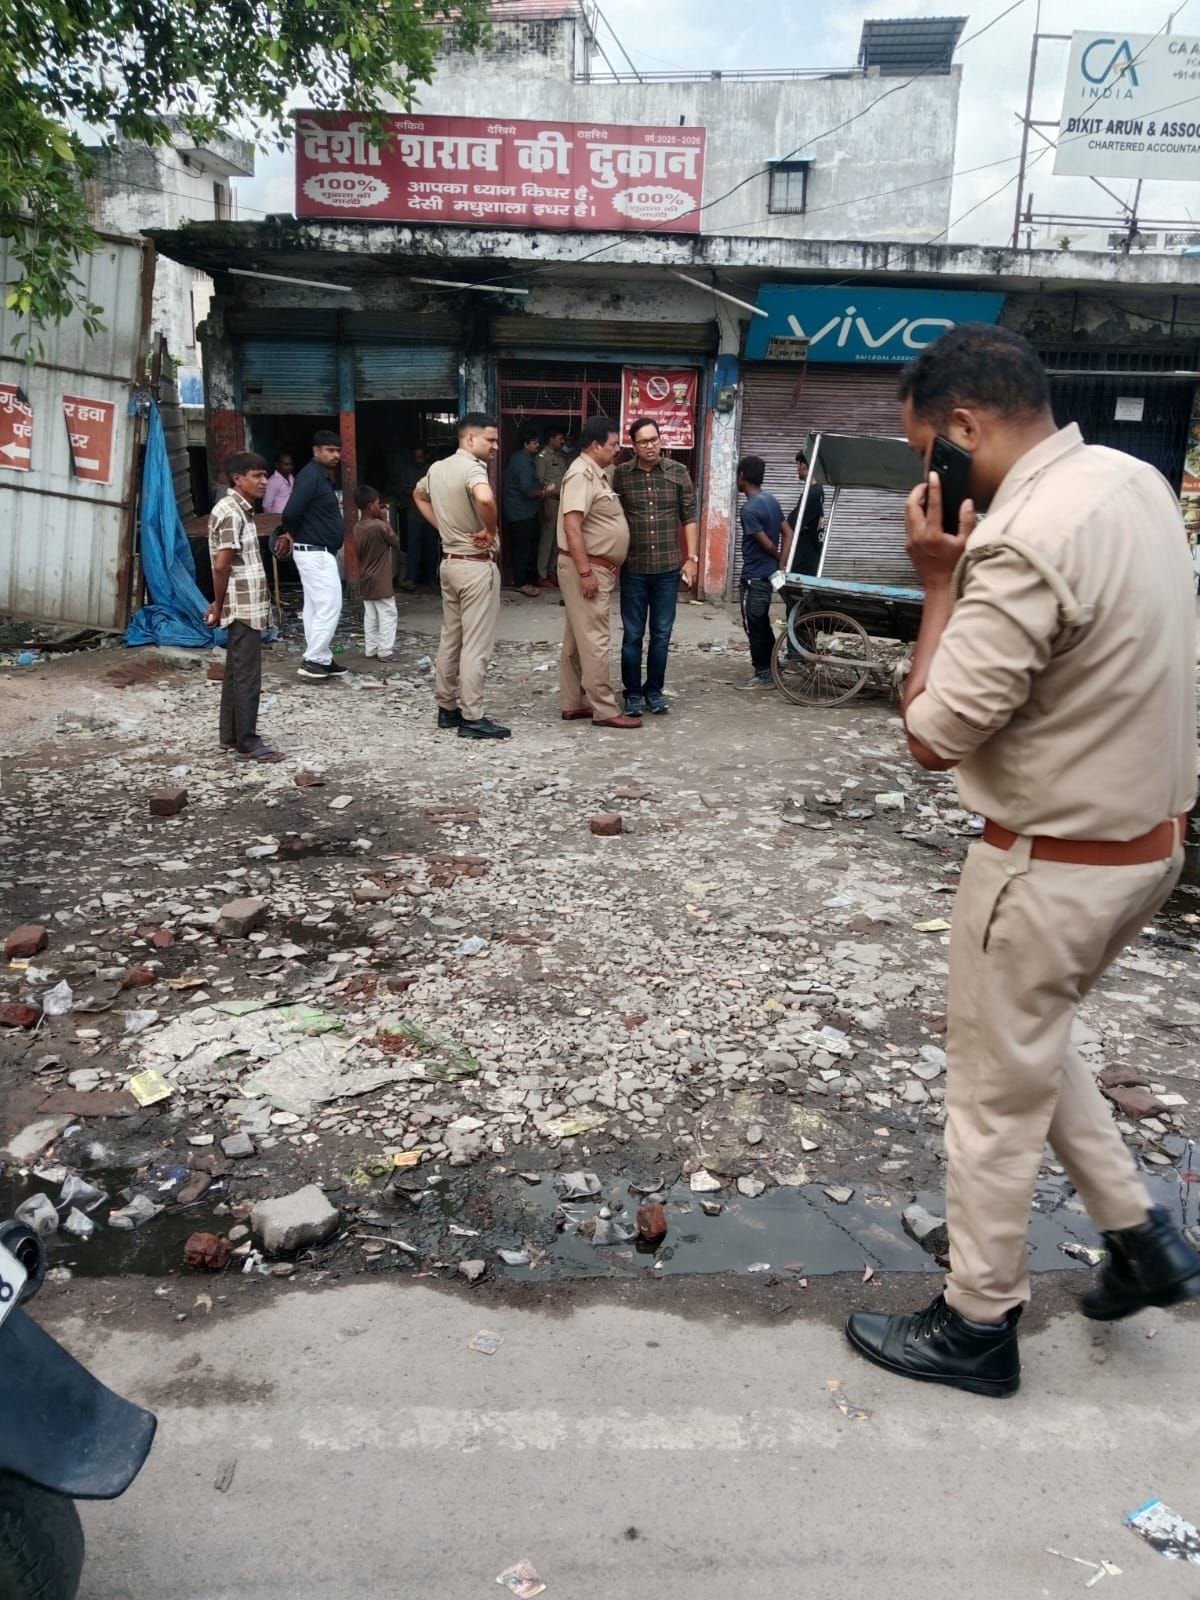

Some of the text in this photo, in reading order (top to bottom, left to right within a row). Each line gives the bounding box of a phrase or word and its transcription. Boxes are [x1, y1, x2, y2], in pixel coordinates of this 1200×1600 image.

[1168, 41, 1200, 55] CA A
[1081, 87, 1134, 99] INDIA
[487, 124, 517, 135] देखिये
[1067, 117, 1103, 134] DIXIT
[1105, 119, 1143, 135] ARUN
[1146, 121, 1156, 136] &
[1088, 140, 1144, 152] CHARTERED
[300, 119, 701, 189] देशी शराब की दुकान
[315, 178, 377, 192] 100%
[408, 181, 468, 195] आपका
[473, 184, 516, 196] ध्यान
[521, 182, 571, 199] किधर
[408, 195, 443, 210] देसी
[453, 200, 527, 217] मधुशाला
[532, 203, 571, 216] इधर
[624, 192, 683, 206] 100%
[78, 405, 107, 422] हवा
